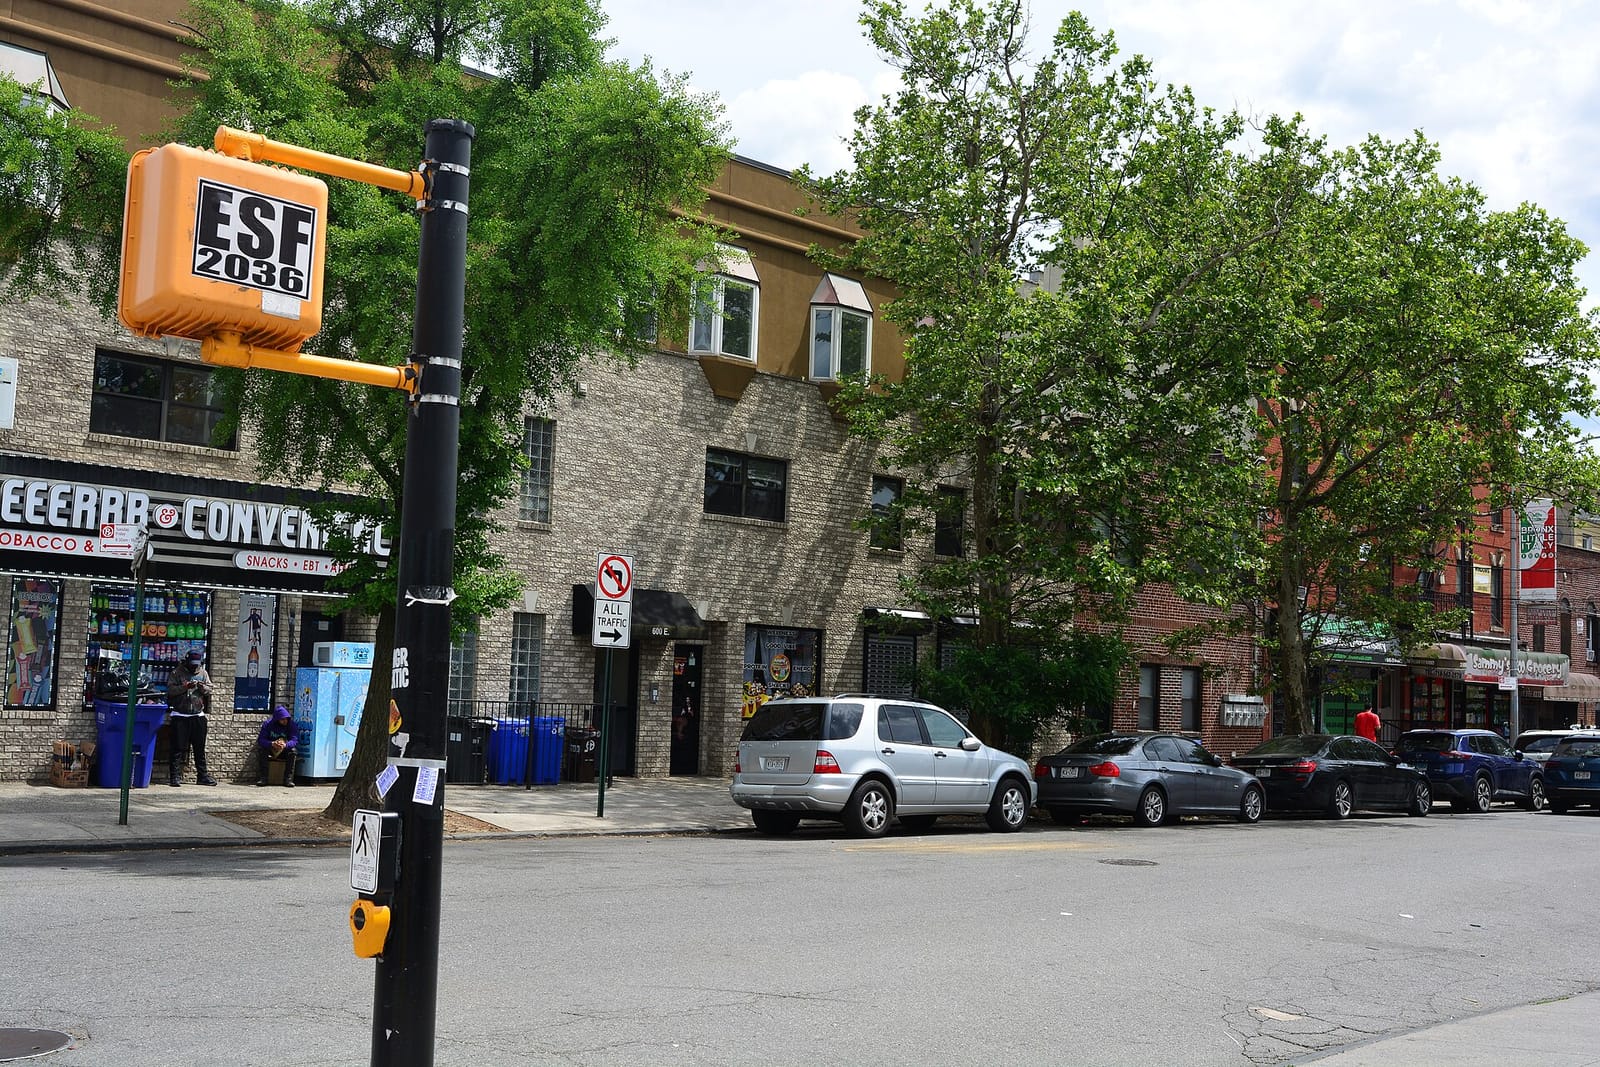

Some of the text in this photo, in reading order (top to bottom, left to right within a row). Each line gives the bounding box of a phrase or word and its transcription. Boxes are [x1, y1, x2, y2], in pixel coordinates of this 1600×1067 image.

[197, 185, 313, 266] ESF
[196, 247, 304, 293] 2036
[0, 532, 94, 552] OBACCO &
[246, 555, 288, 569] SNACKS
[303, 560, 320, 571] EBT
[603, 603, 623, 616] ALL
[597, 617, 627, 628] TRAFFIC
[1473, 654, 1510, 675] Sammy's
[1526, 659, 1562, 679] Grocery
